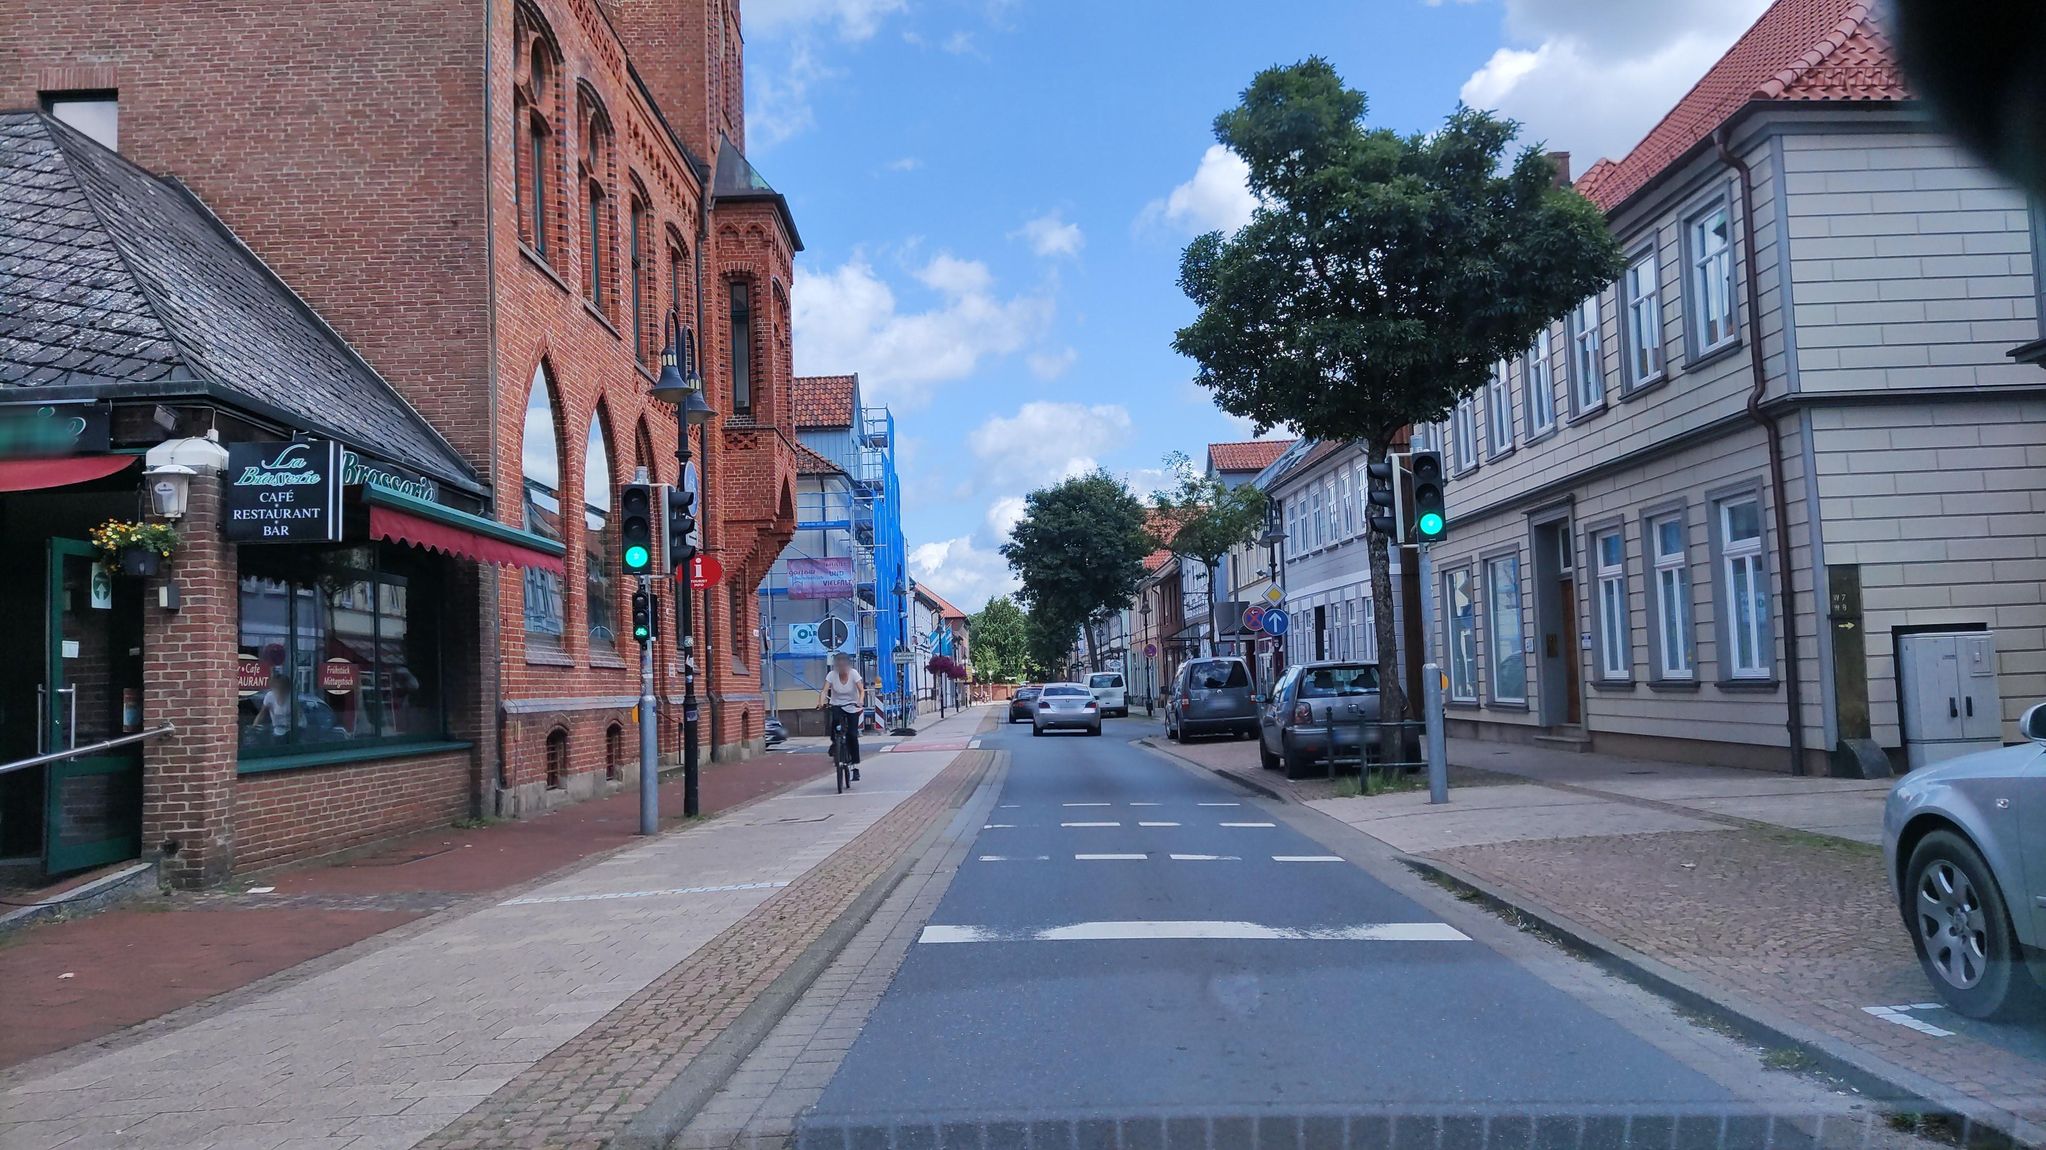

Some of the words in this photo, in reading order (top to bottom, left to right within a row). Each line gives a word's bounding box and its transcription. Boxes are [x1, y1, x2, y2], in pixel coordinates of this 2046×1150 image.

[261, 443, 310, 469] La
[233, 466, 321, 487] Brasserie
[343, 450, 436, 502] Brasserie
[259, 489, 294, 503] CAFÉ
[233, 507, 321, 520] RESTAURANT
[263, 524, 289, 536] BAR
[237, 676, 269, 687] AURANT
